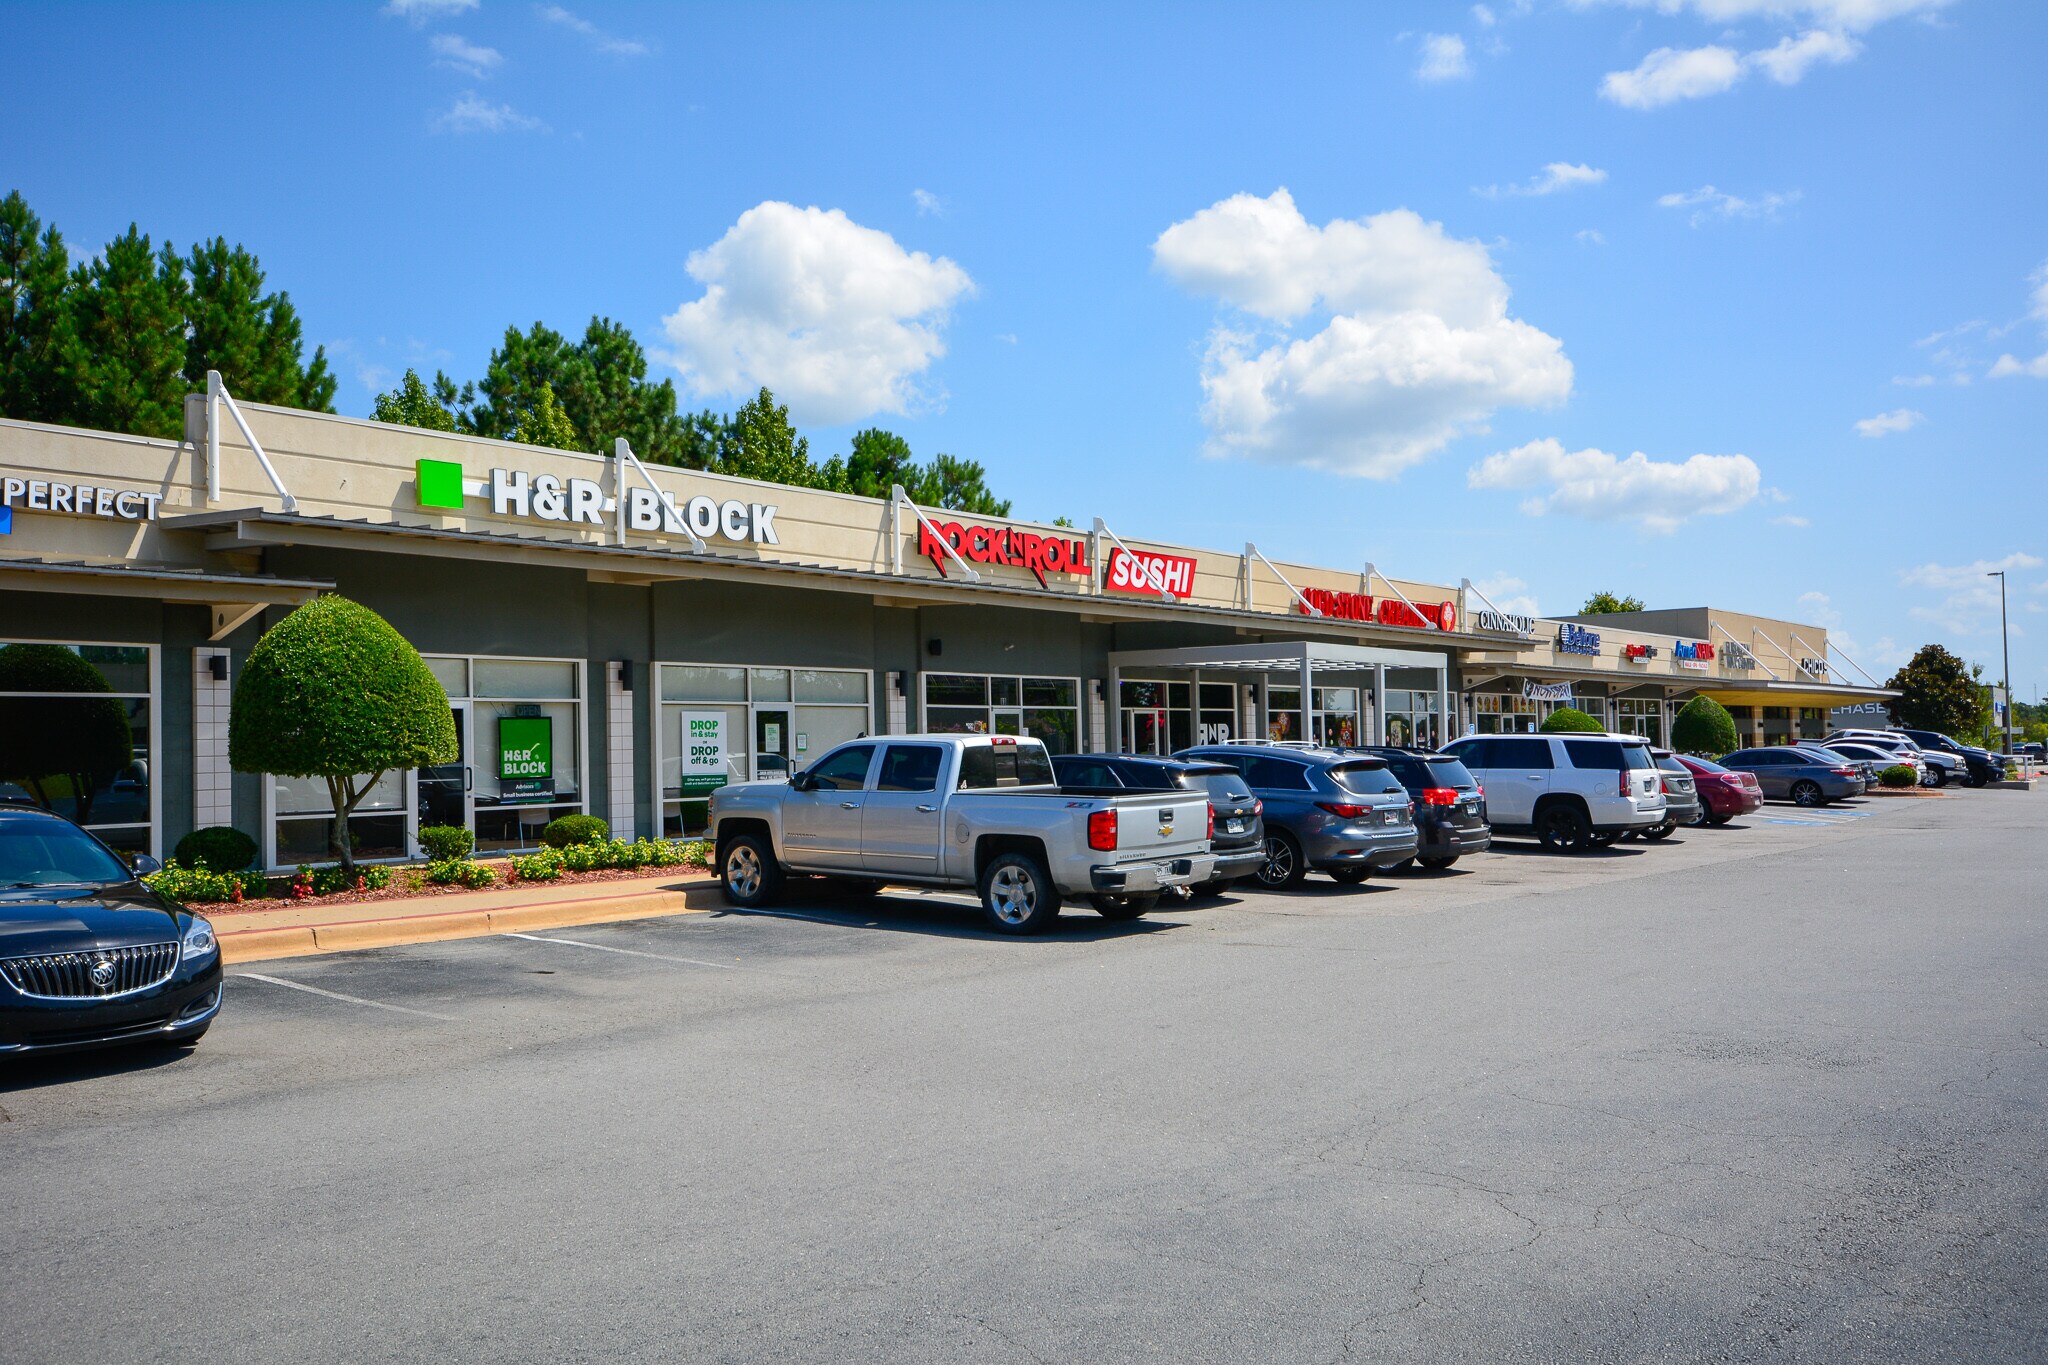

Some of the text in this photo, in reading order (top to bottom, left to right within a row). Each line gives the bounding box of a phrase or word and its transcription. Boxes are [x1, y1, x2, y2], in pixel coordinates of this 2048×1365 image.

[2, 477, 163, 520] PERFECT
[490, 467, 780, 545] H&R BLOCK
[917, 518, 1008, 578] ROCK
[1024, 533, 1093, 590] ROLL
[1112, 552, 1192, 594] SUSHI
[690, 720, 718, 730] DROP
[704, 731, 718, 739] stay
[504, 750, 531, 762] H&R
[691, 746, 719, 756] DROP
[691, 756, 701, 765] off
[709, 757, 719, 766] go
[504, 761, 546, 775] BLOCK
